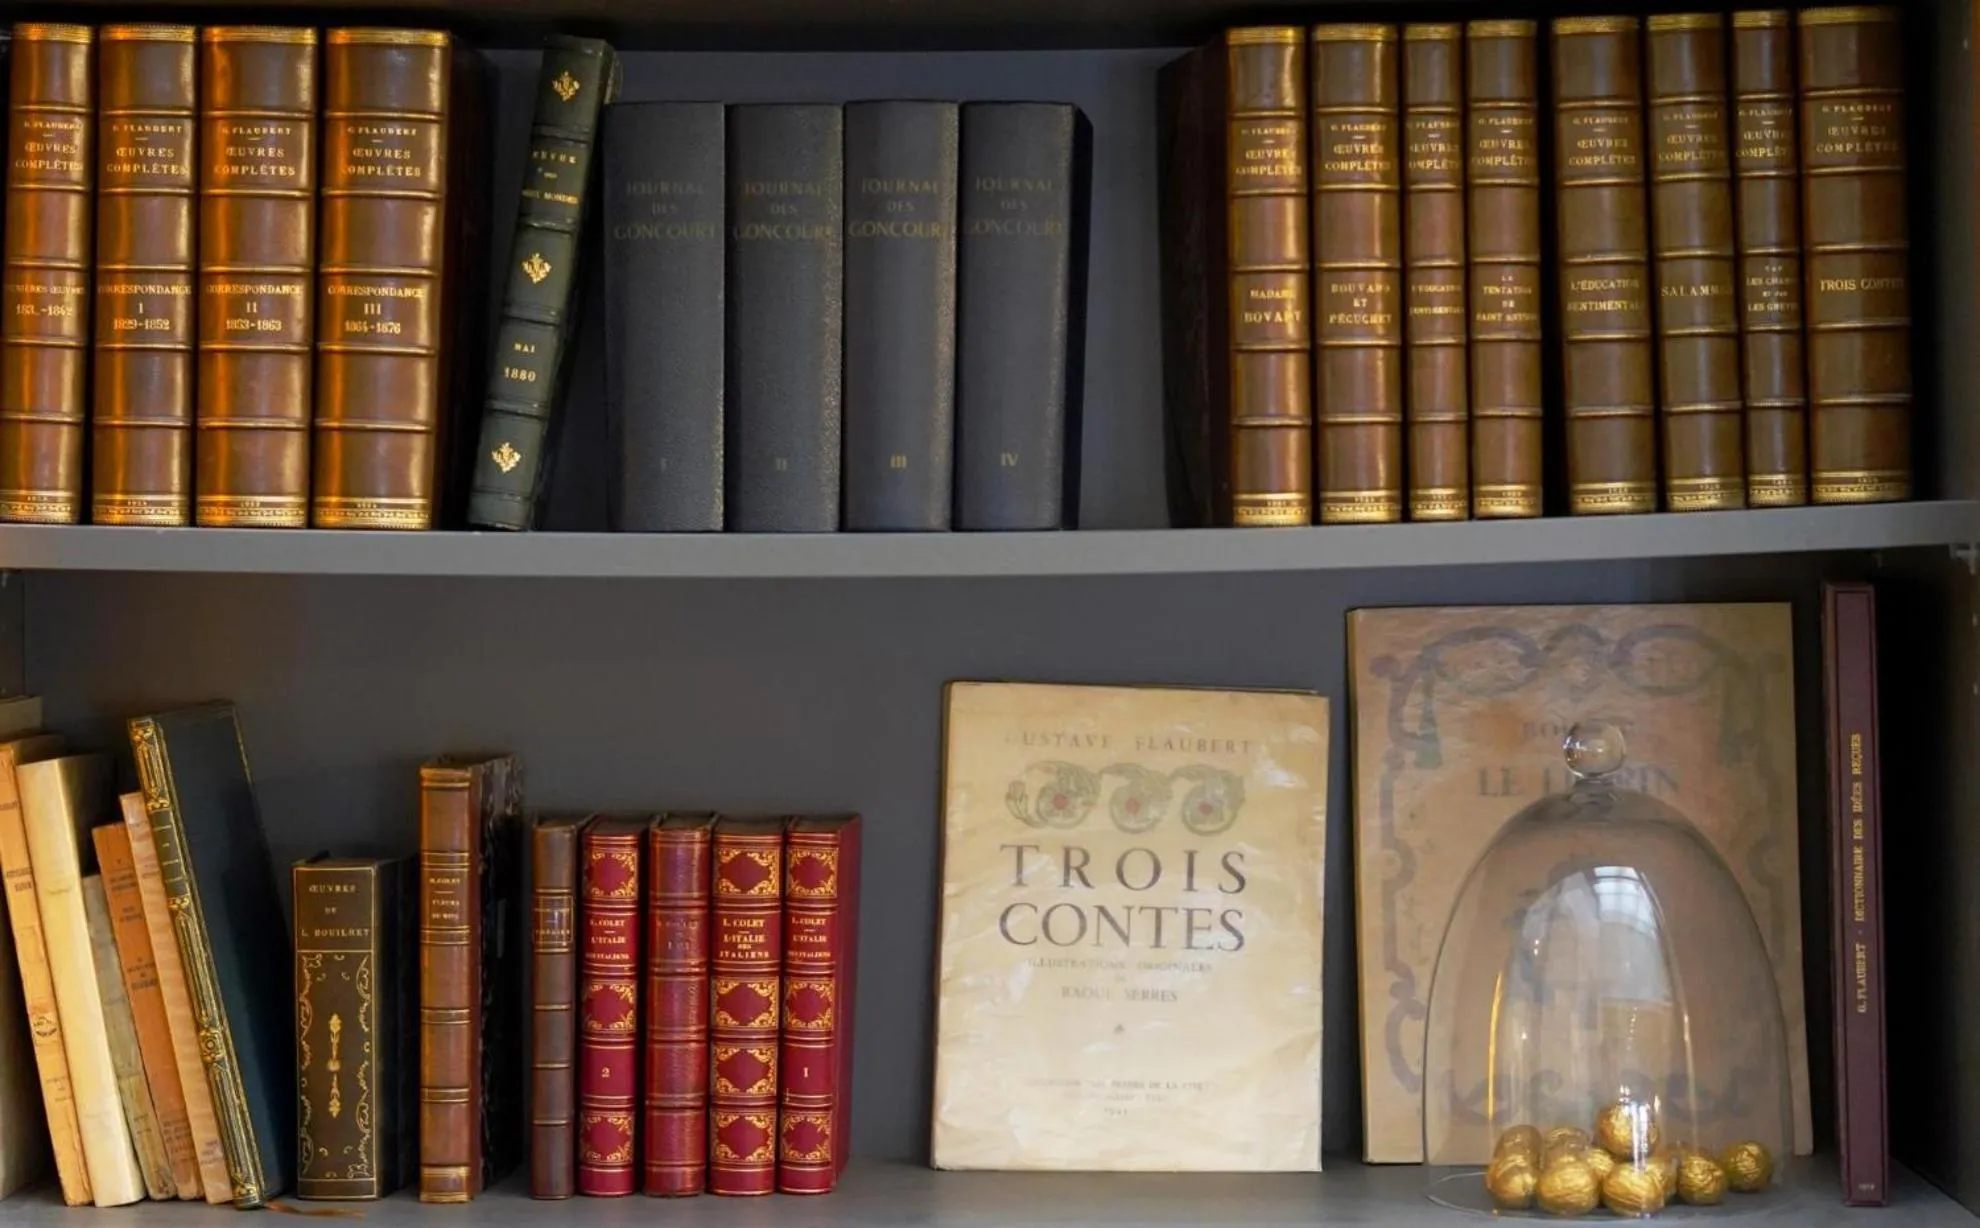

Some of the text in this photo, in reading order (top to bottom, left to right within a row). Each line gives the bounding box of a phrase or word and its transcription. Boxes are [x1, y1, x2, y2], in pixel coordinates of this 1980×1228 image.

[116, 147, 175, 158] ŒUVRES
[226, 147, 285, 158] ŒUVRES
[353, 148, 411, 159] ŒUVRES
[1820, 279, 1857, 292] TROIS
[246, 301, 258, 314] II
[363, 303, 381, 315] III
[504, 367, 536, 382] 1880
[776, 457, 788, 471] II
[890, 454, 908, 469] III
[1000, 451, 1020, 467] IV
[1136, 736, 1255, 754] FLAUBERT
[1852, 819, 1863, 839] DES
[1000, 844, 1246, 894] TROIS
[1853, 845, 1865, 921] DICTIONNAIRE
[733, 919, 765, 928] COLET
[999, 902, 1246, 951] CONTES
[719, 950, 770, 959] ITALIENS
[1856, 943, 1867, 1000] FLAUBERT
[1125, 987, 1178, 1002] SERRES
[602, 1067, 610, 1077] 2
